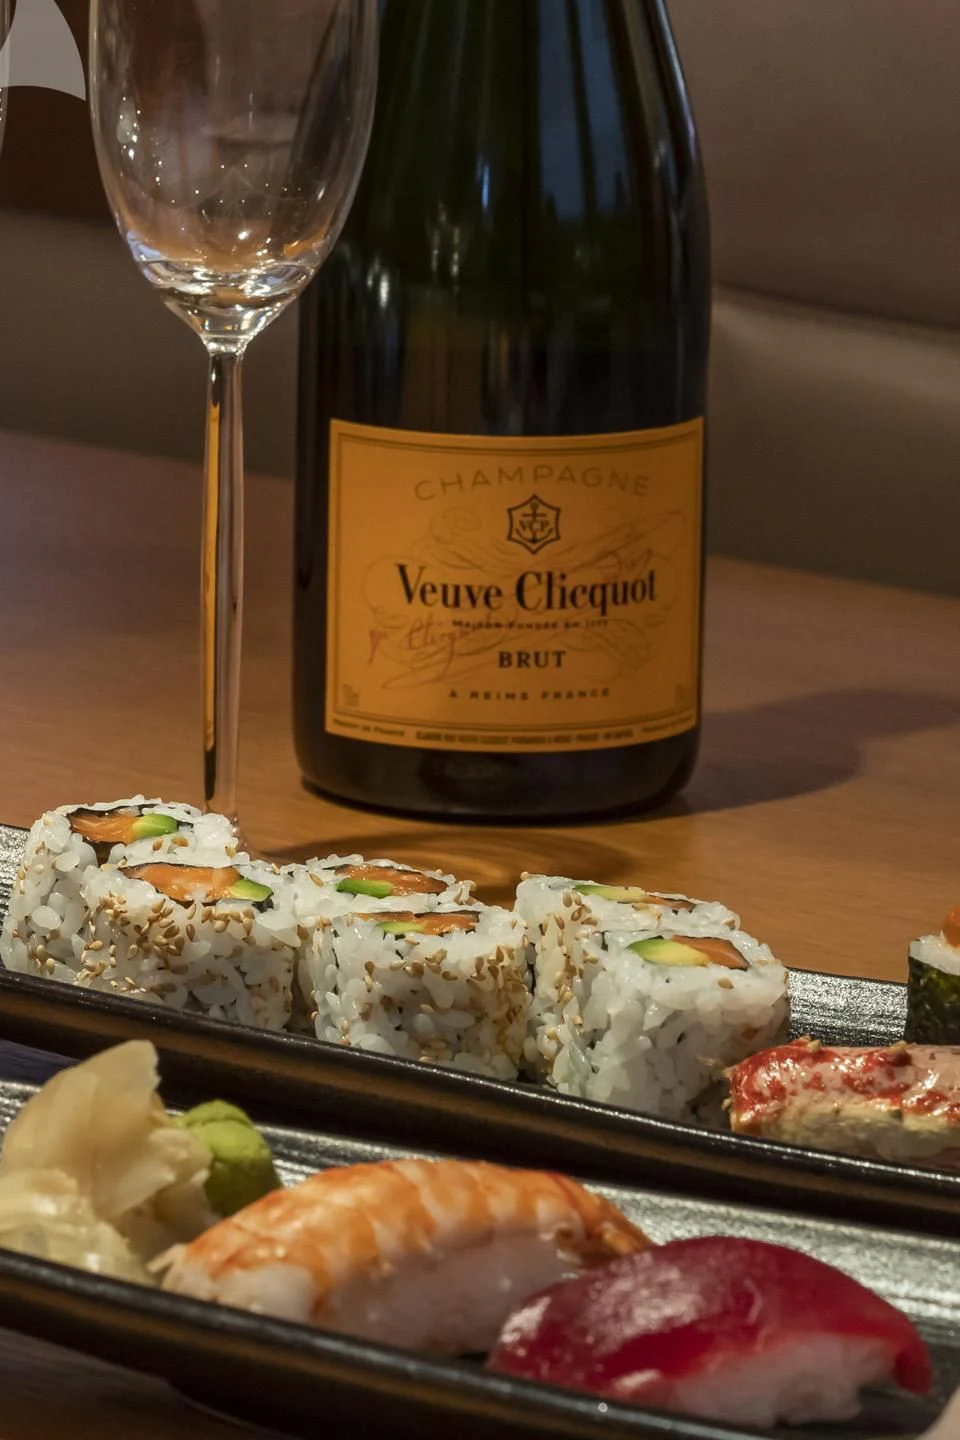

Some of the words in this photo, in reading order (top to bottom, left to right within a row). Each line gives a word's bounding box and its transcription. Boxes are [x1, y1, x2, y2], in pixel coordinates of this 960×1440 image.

[414, 464, 651, 502] CHAMPAGNE
[395, 563, 503, 611] Veuve
[515, 569, 656, 617] Clicquot
[498, 650, 567, 669] BRUT
[469, 689, 529, 702] REIMS
[541, 687, 610, 701] FRANCE
